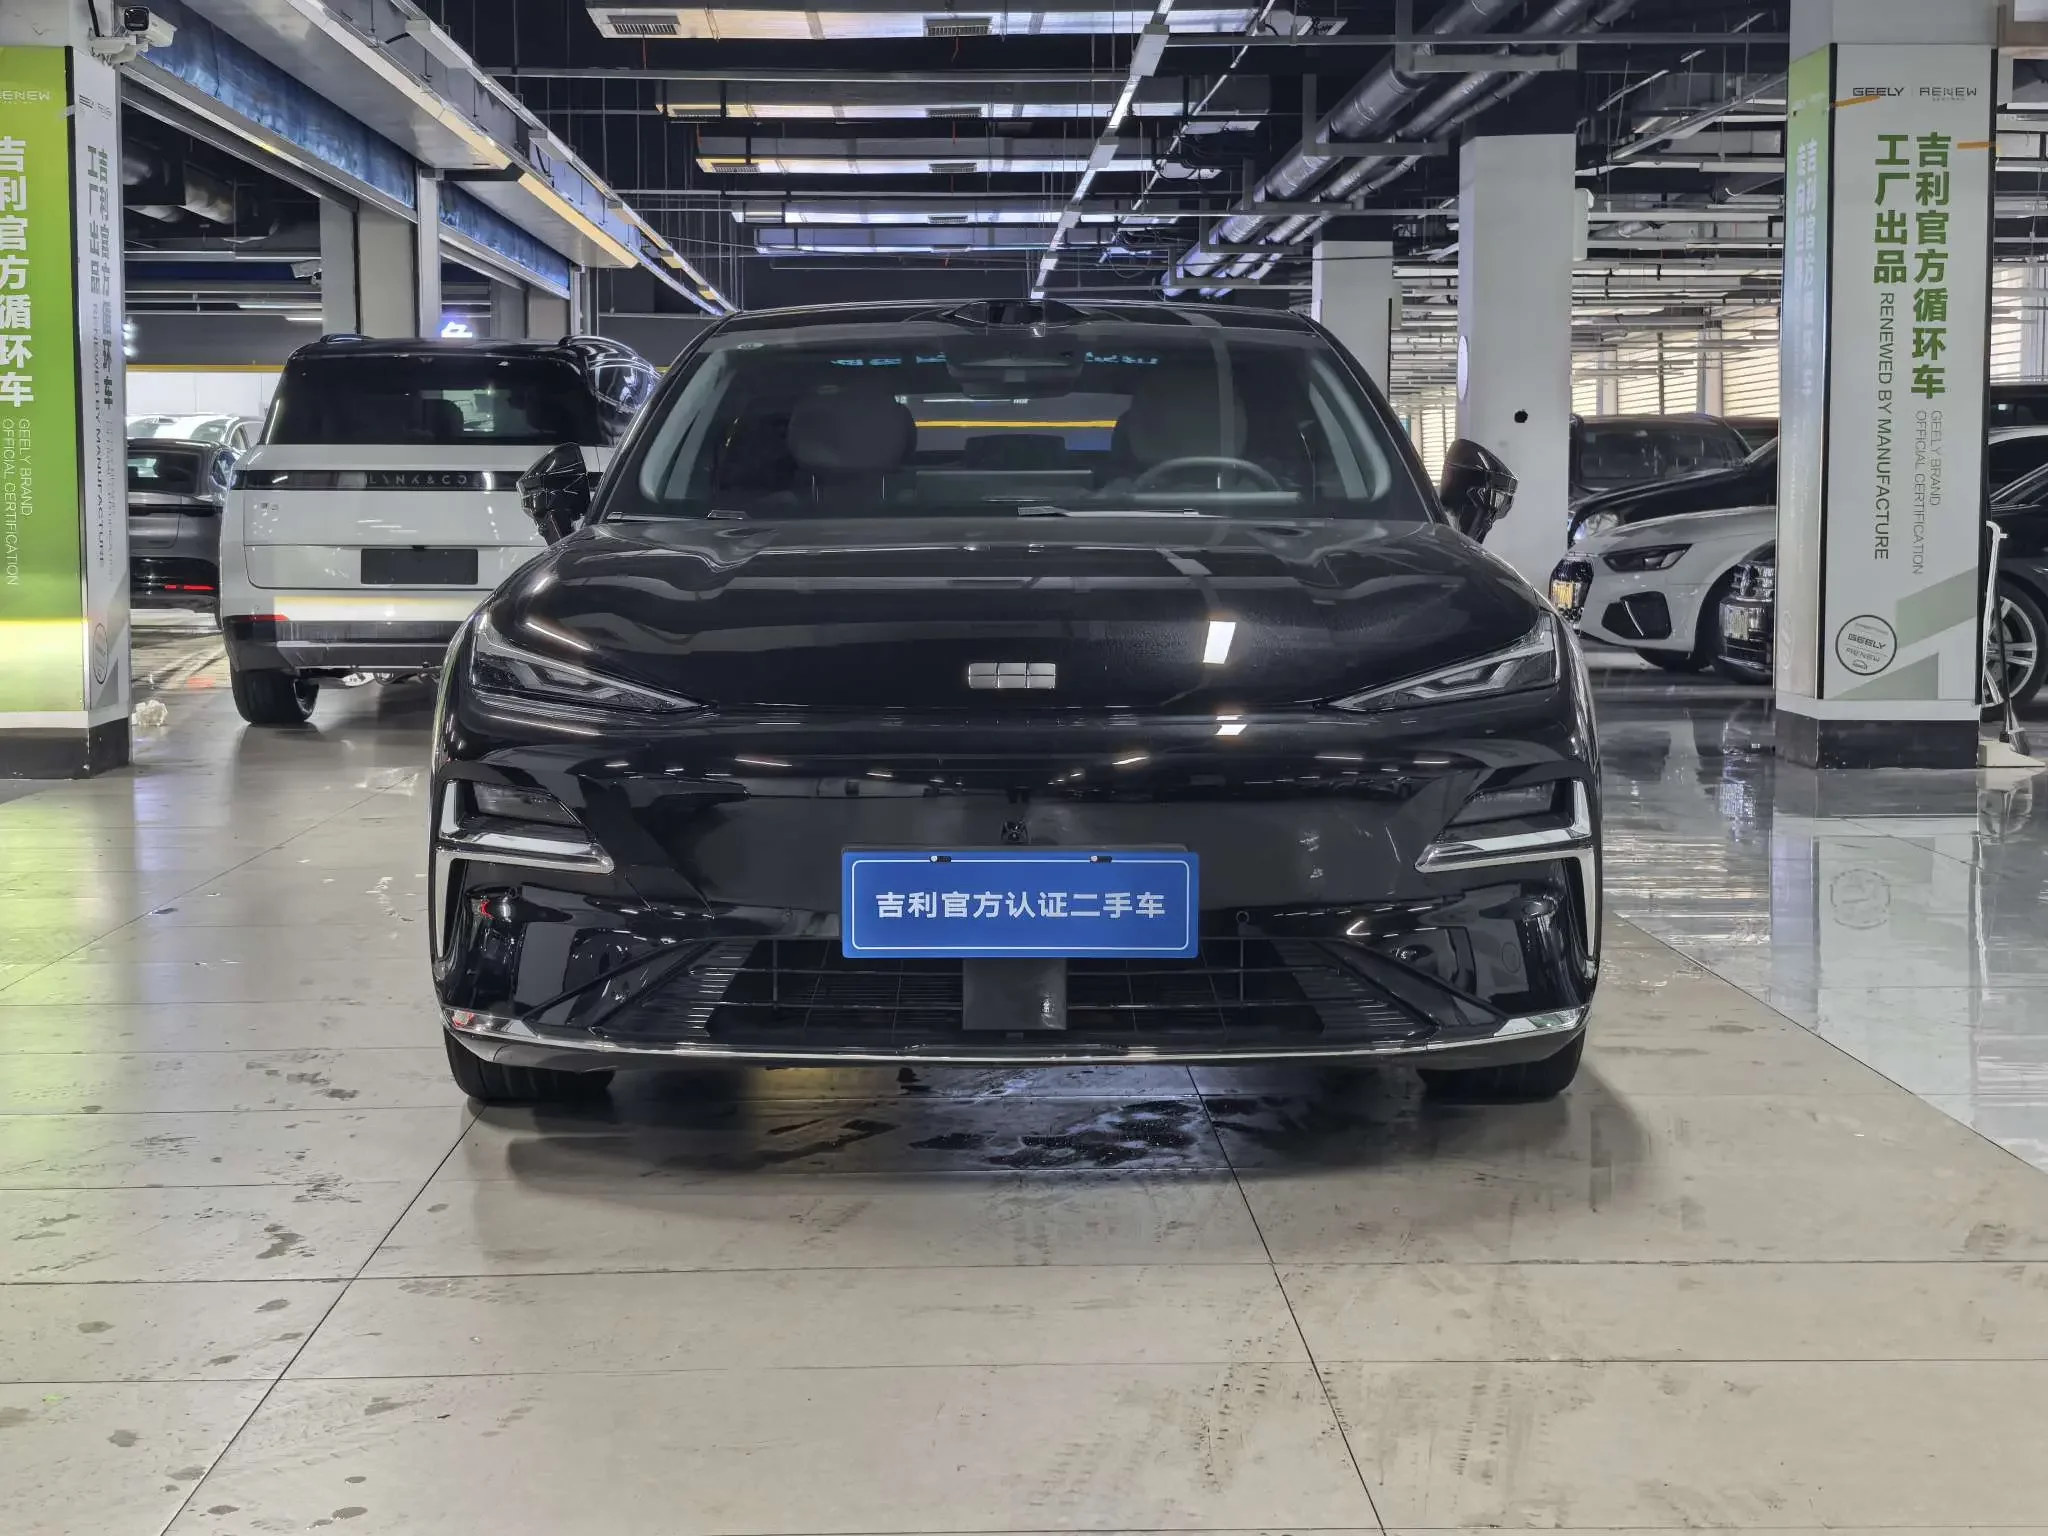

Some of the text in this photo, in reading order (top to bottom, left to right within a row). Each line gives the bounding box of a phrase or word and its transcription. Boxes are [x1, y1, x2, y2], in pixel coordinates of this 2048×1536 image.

[0, 90, 50, 100] ENEW
[1853, 87, 1904, 97] GEELY
[1919, 87, 1977, 97] RENEW
[1873, 134, 1910, 284] 工厂出品
[0, 136, 33, 408] 吉利官方循环车
[1911, 131, 1951, 399] 吉利官方循环车
[19, 418, 32, 516] GEELY BRAND
[1875, 292, 1894, 560] RENEWED BY MANUFACTURE
[1929, 410, 1943, 506] GEELY BRAND
[2, 418, 20, 586] OFFICIAL CERTIFICATION
[1912, 410, 1927, 575] OFFICIAL CERTIFICATION
[1848, 633, 1886, 649] GEELY
[875, 891, 1165, 919] 吉利官方认证二手车
